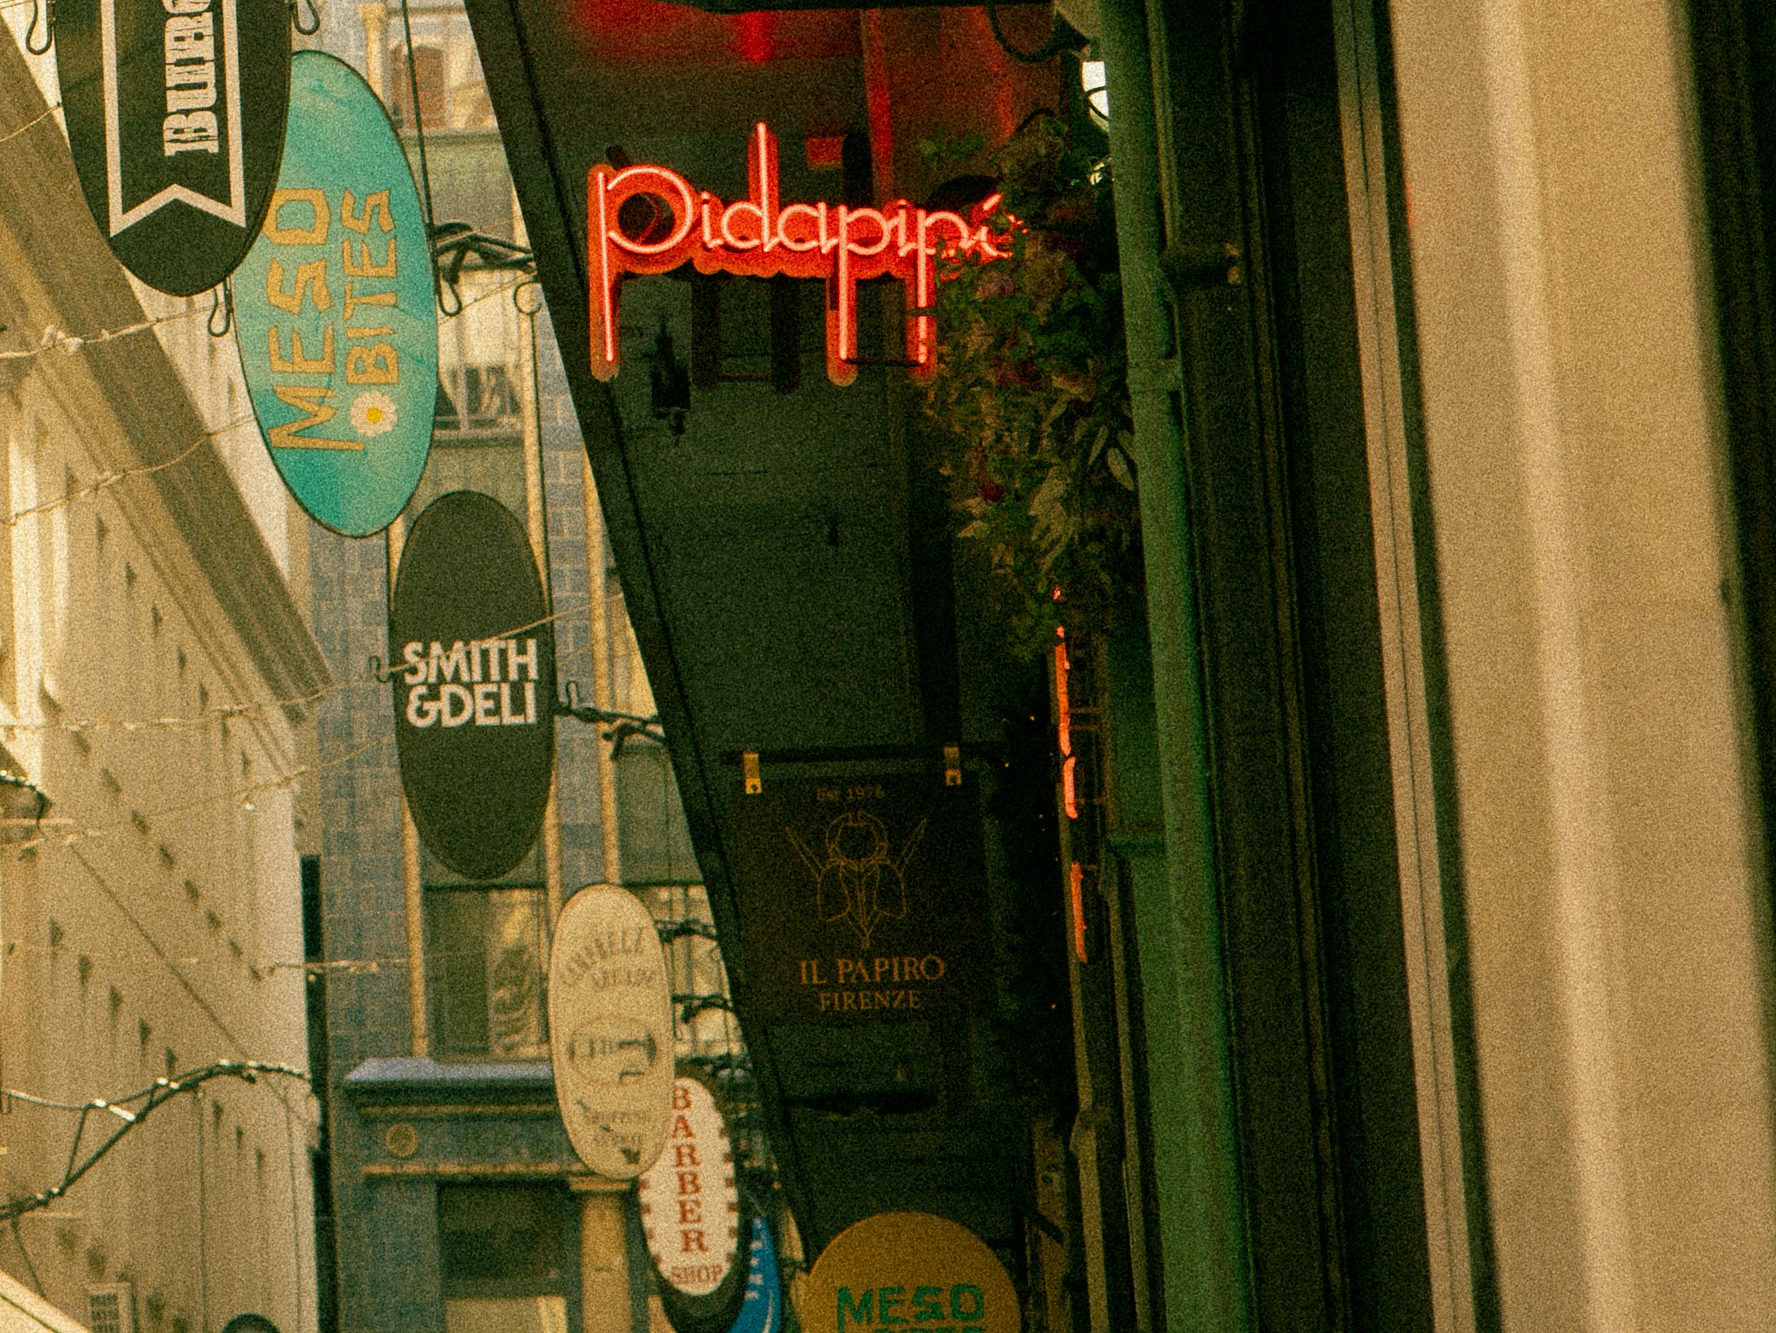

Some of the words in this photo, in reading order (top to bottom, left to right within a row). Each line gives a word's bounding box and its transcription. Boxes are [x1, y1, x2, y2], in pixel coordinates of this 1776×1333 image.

[340, 186, 401, 387] BITES
[263, 186, 366, 453] MESO
[402, 637, 540, 685] SMITH
[405, 683, 539, 729] &DELI
[798, 958, 828, 986] IL
[836, 955, 945, 986] PAPIRO
[818, 989, 923, 1012] FIRENZE
[671, 1086, 710, 1254] BARBER
[670, 1264, 724, 1286] SHOP
[835, 1283, 985, 1333] MESO
